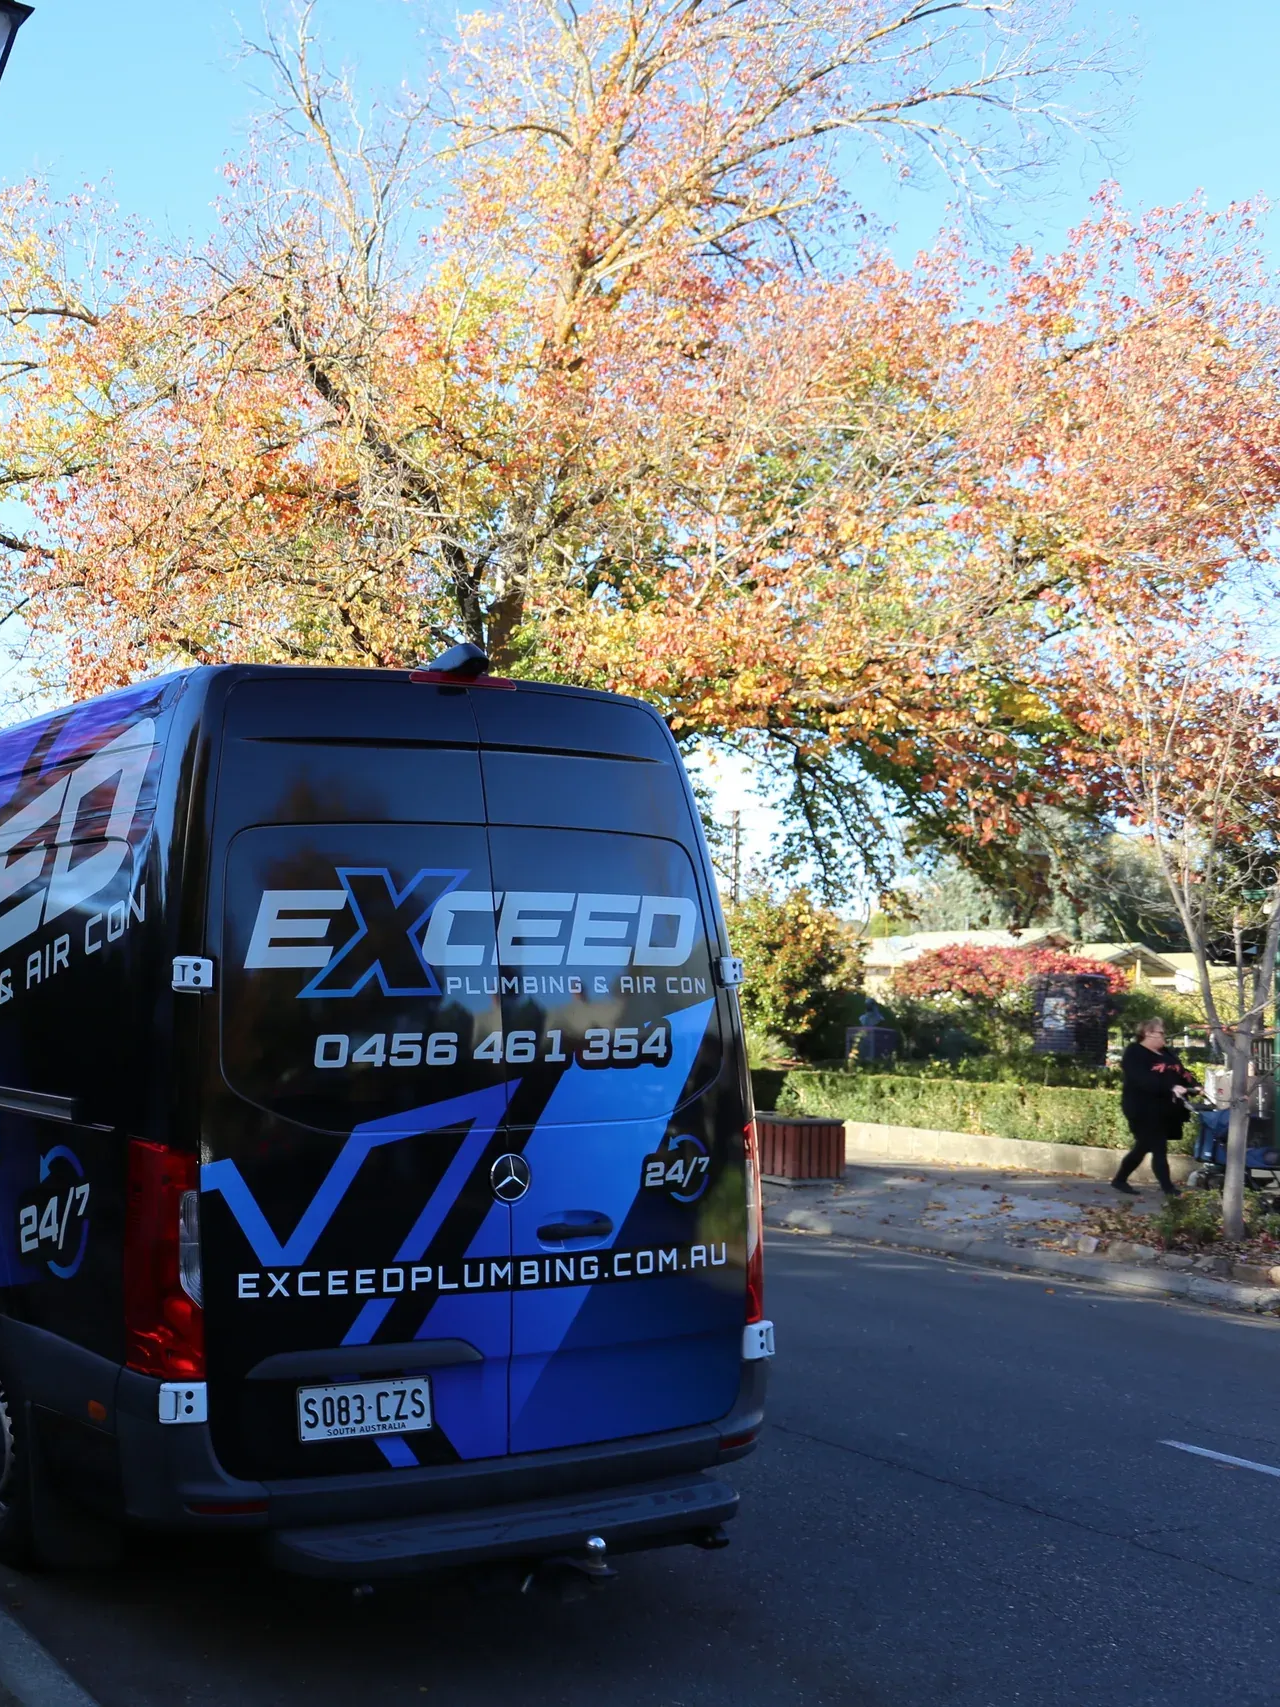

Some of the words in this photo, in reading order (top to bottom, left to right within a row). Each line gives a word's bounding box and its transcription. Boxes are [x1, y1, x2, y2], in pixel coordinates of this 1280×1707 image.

[26, 933, 70, 990] AIR
[84, 883, 146, 956] CON
[243, 867, 699, 998] EXCEED
[446, 976, 582, 995] PLUMBING
[593, 976, 609, 994] &
[620, 976, 656, 995] AIR
[666, 976, 707, 995] CON
[314, 1031, 458, 1069] 0456
[473, 1030, 567, 1064] 461
[582, 1027, 668, 1061] 354
[645, 1156, 710, 1188] 24/7
[20, 1183, 90, 1254] 24/7
[238, 1242, 727, 1299] EXCEEDPLUMBING.COM.AU
[327, 1426, 356, 1437] SOUTH
[359, 1421, 407, 1433] AUSTRALIA
